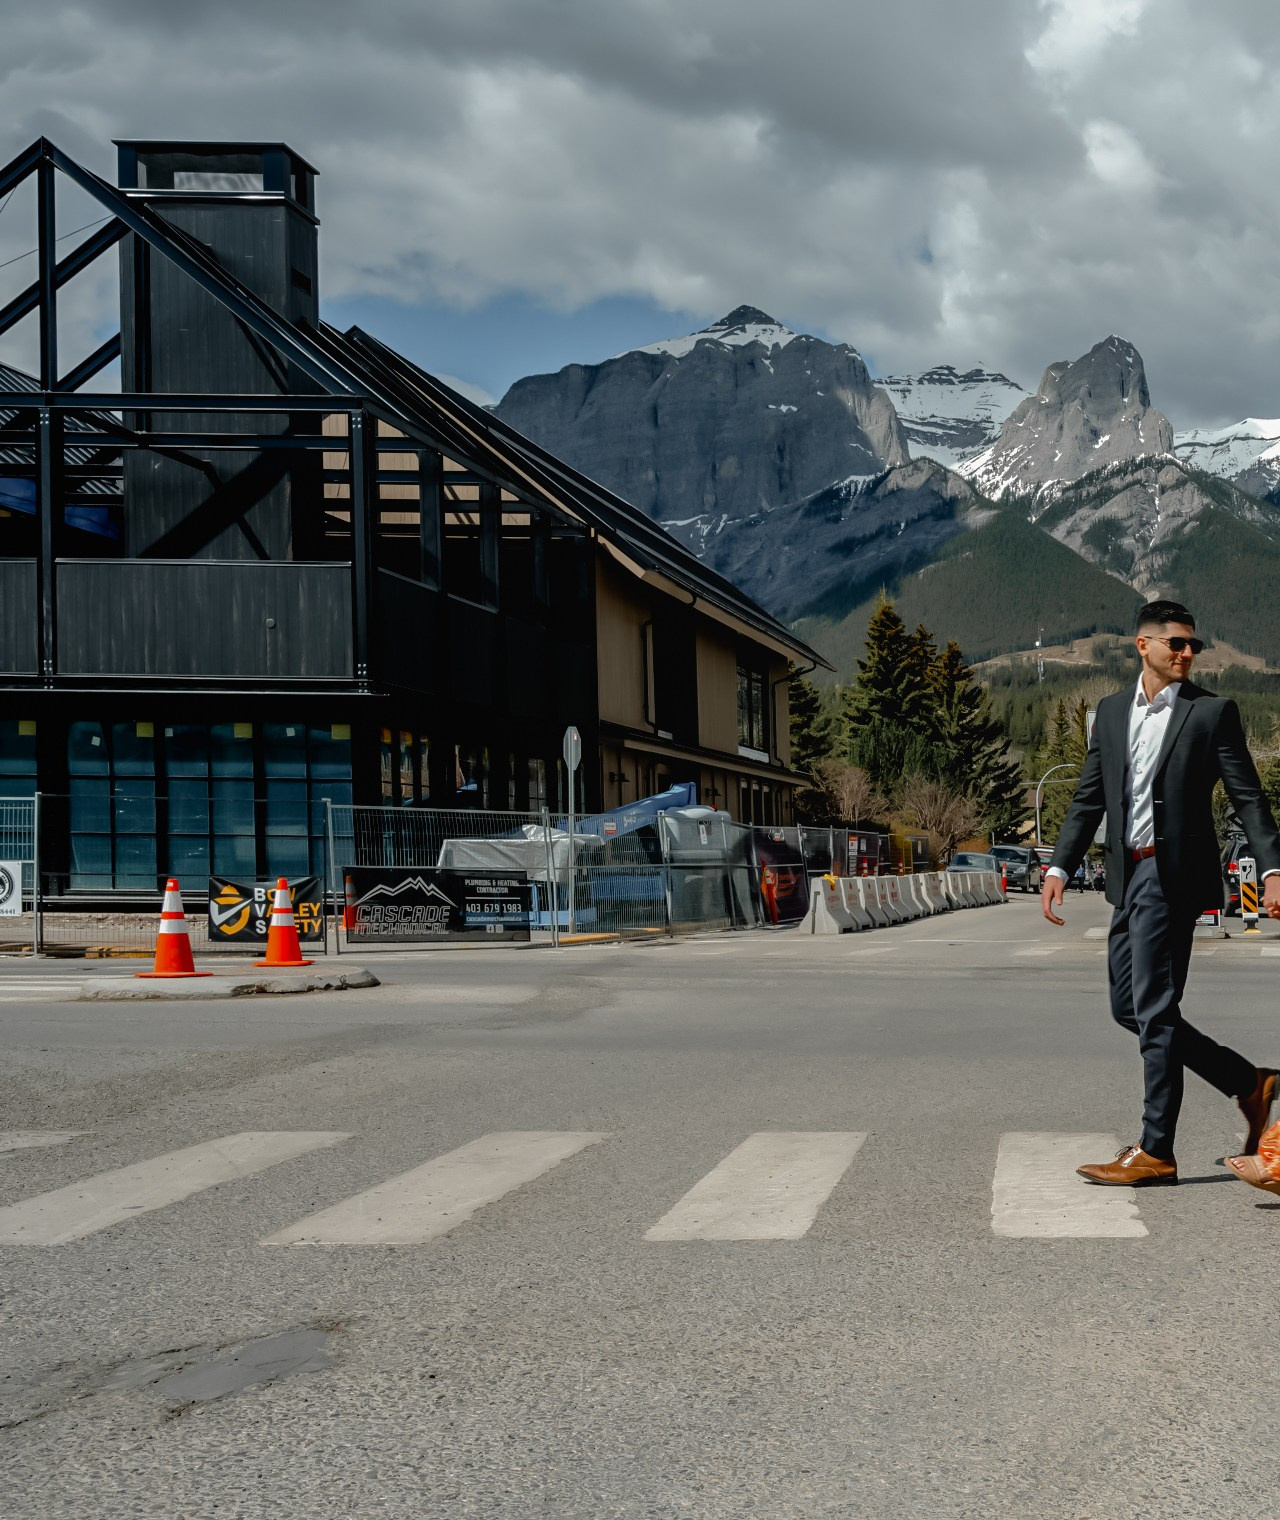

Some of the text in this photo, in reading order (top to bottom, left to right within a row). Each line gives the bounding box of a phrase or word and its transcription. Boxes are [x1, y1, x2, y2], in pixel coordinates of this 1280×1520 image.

[356, 905, 451, 923] CASCADE
[465, 903, 522, 913] 403 679 1983
[354, 922, 450, 935] MECHANICAL
